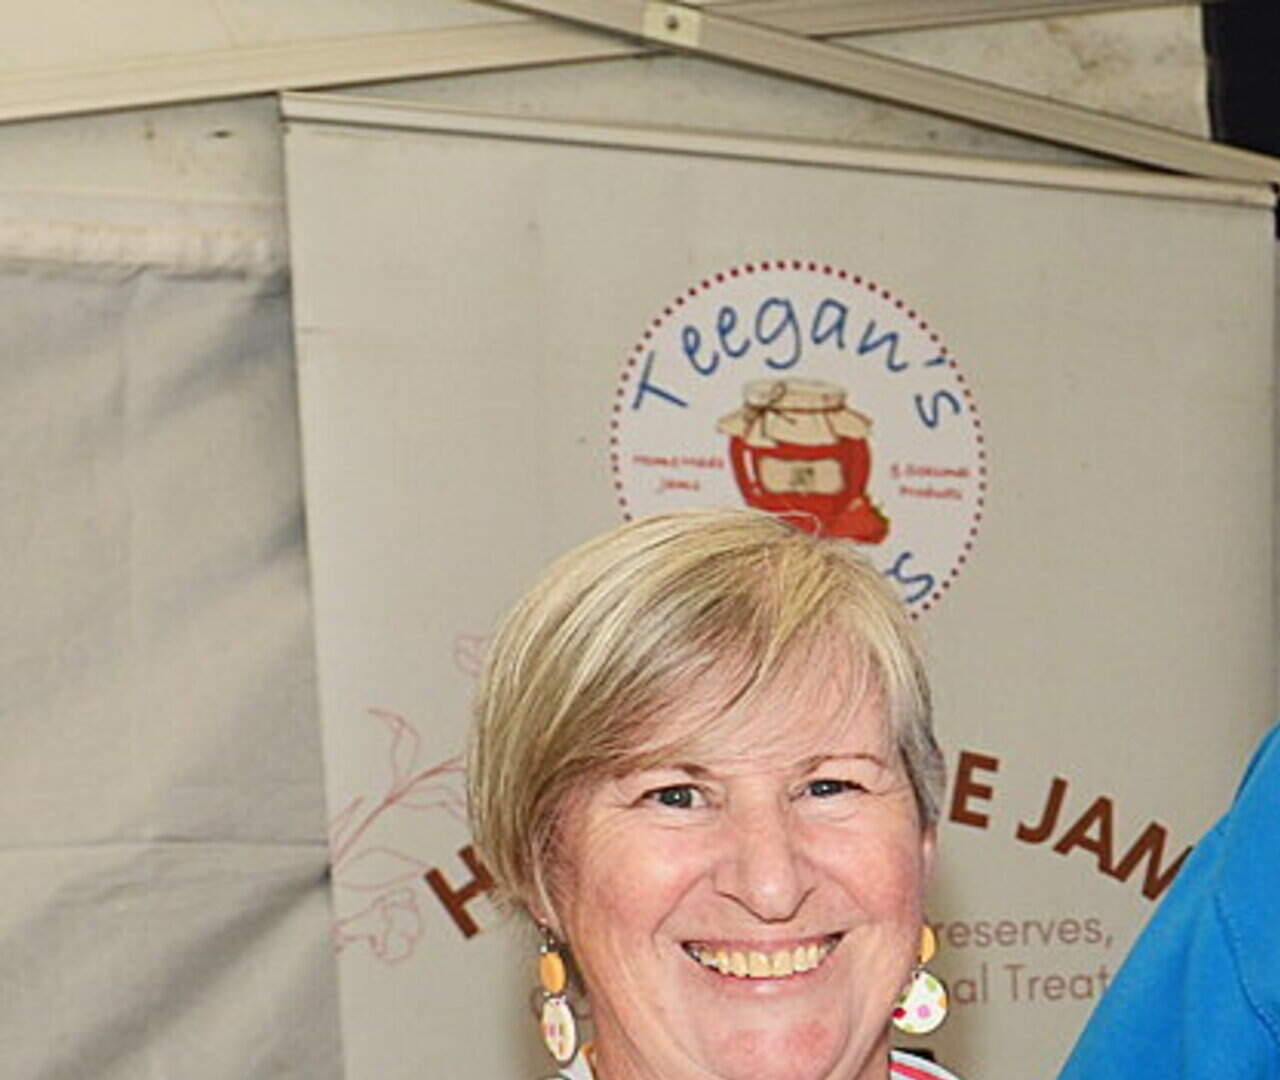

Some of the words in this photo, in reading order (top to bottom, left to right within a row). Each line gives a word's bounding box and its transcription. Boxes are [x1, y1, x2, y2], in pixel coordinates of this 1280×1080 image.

[632, 297, 962, 429] Teegan's
[935, 917, 1113, 948] reserves,
[1003, 963, 1110, 1001] Treat
